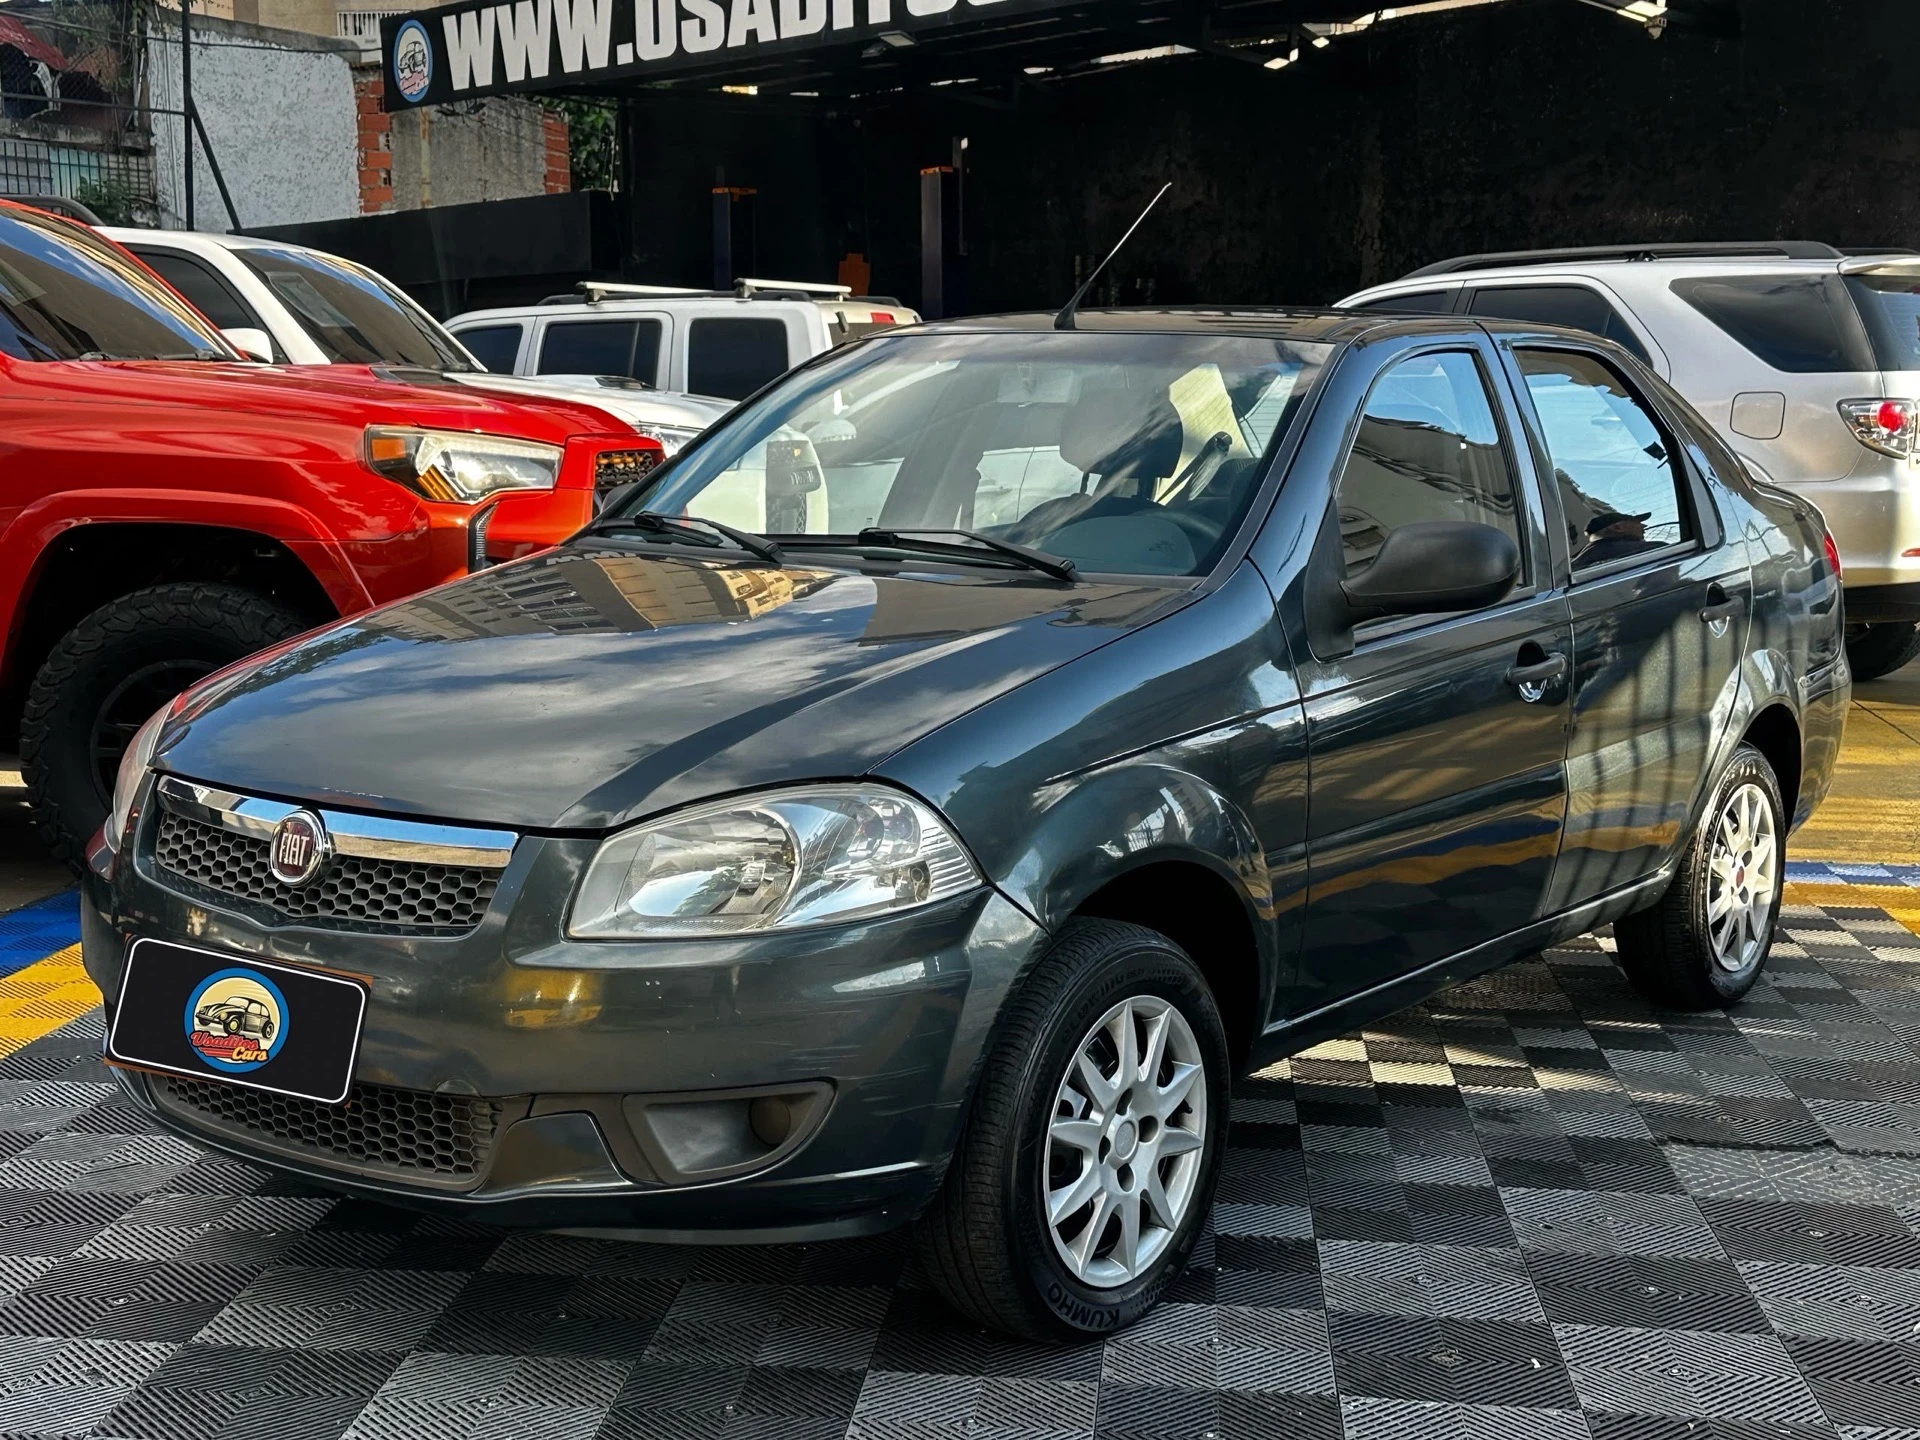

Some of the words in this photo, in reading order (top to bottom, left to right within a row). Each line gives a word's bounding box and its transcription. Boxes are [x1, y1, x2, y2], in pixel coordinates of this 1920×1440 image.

[279, 832, 310, 867] FIAT
[190, 1031, 259, 1051] Usaditos
[231, 1046, 269, 1061] Cars
[1046, 1281, 1121, 1329] KUMHO
